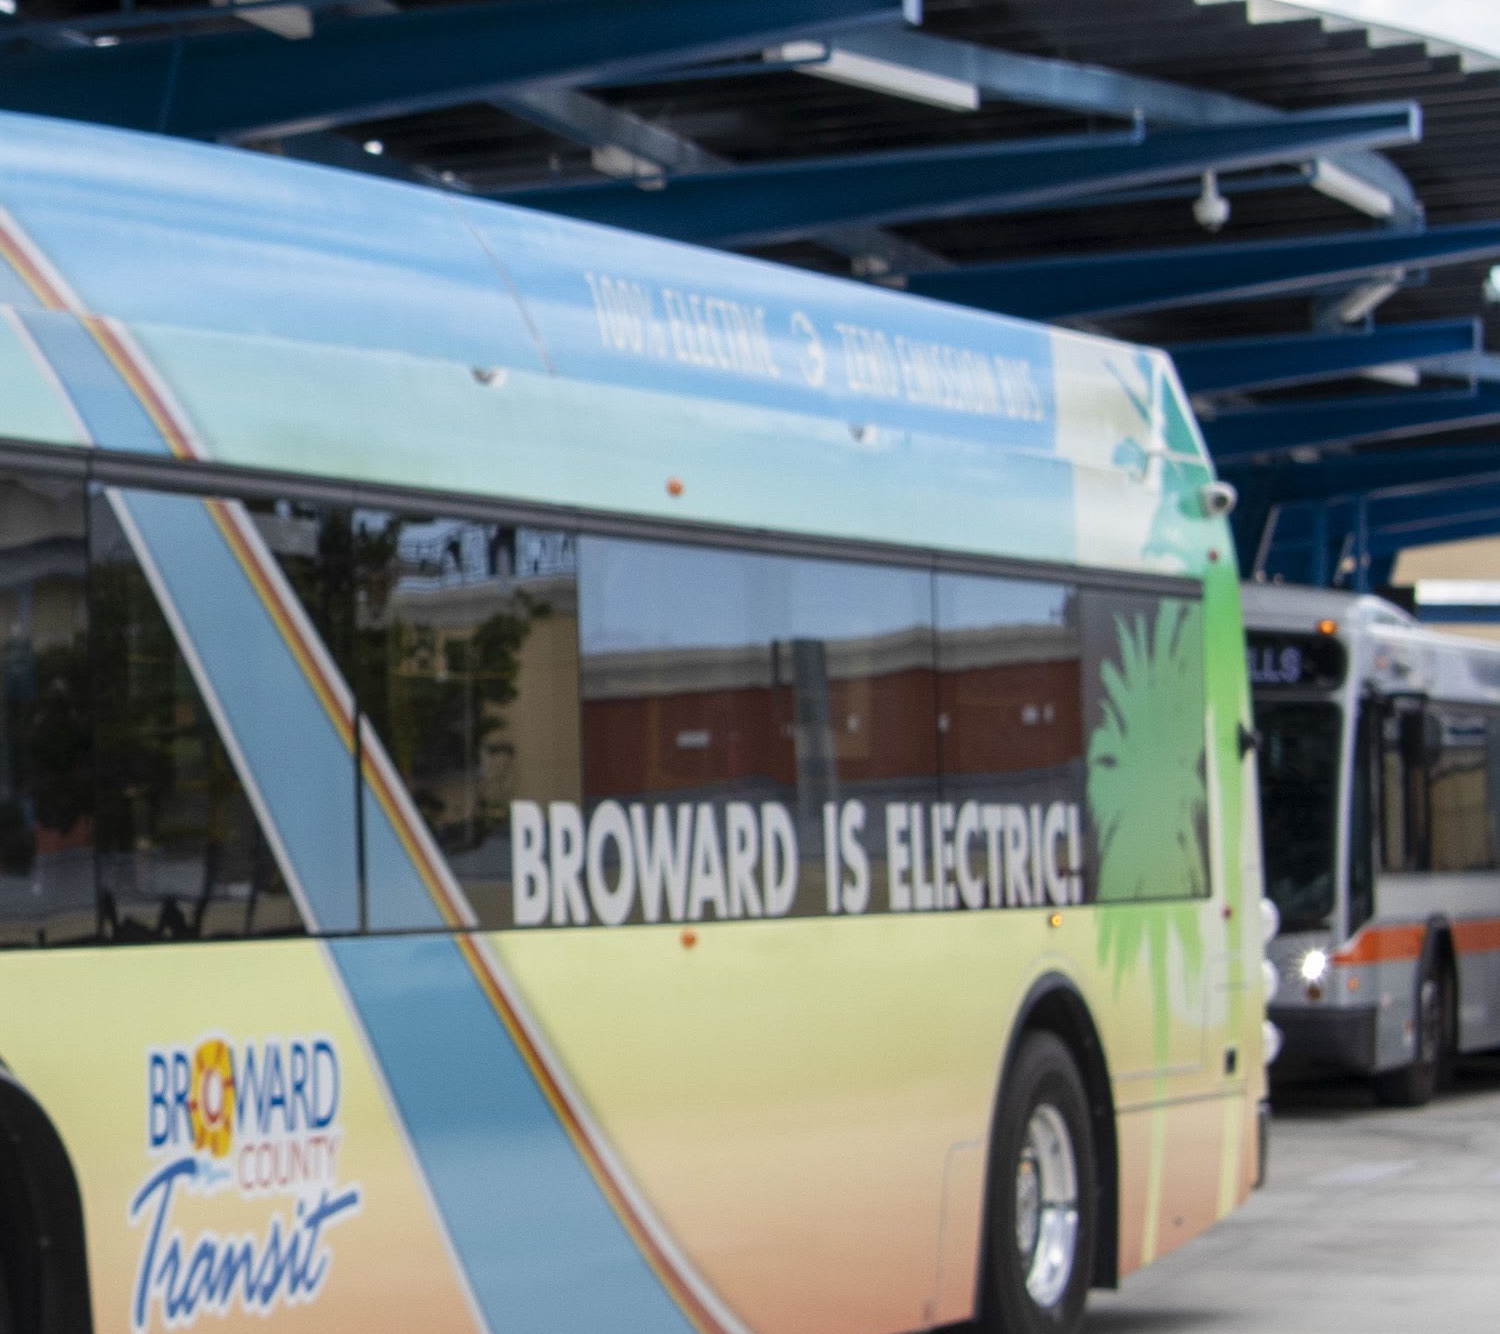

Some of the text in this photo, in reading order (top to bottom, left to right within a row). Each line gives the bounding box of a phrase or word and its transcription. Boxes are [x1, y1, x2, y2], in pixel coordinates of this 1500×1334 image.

[1247, 646, 1303, 684] LLS
[511, 798, 1084, 927] BROWARD IS ELECTRIC!
[150, 1038, 341, 1159] BROWARD
[238, 1133, 340, 1190] COUNTY
[129, 1155, 359, 1329] Transit
